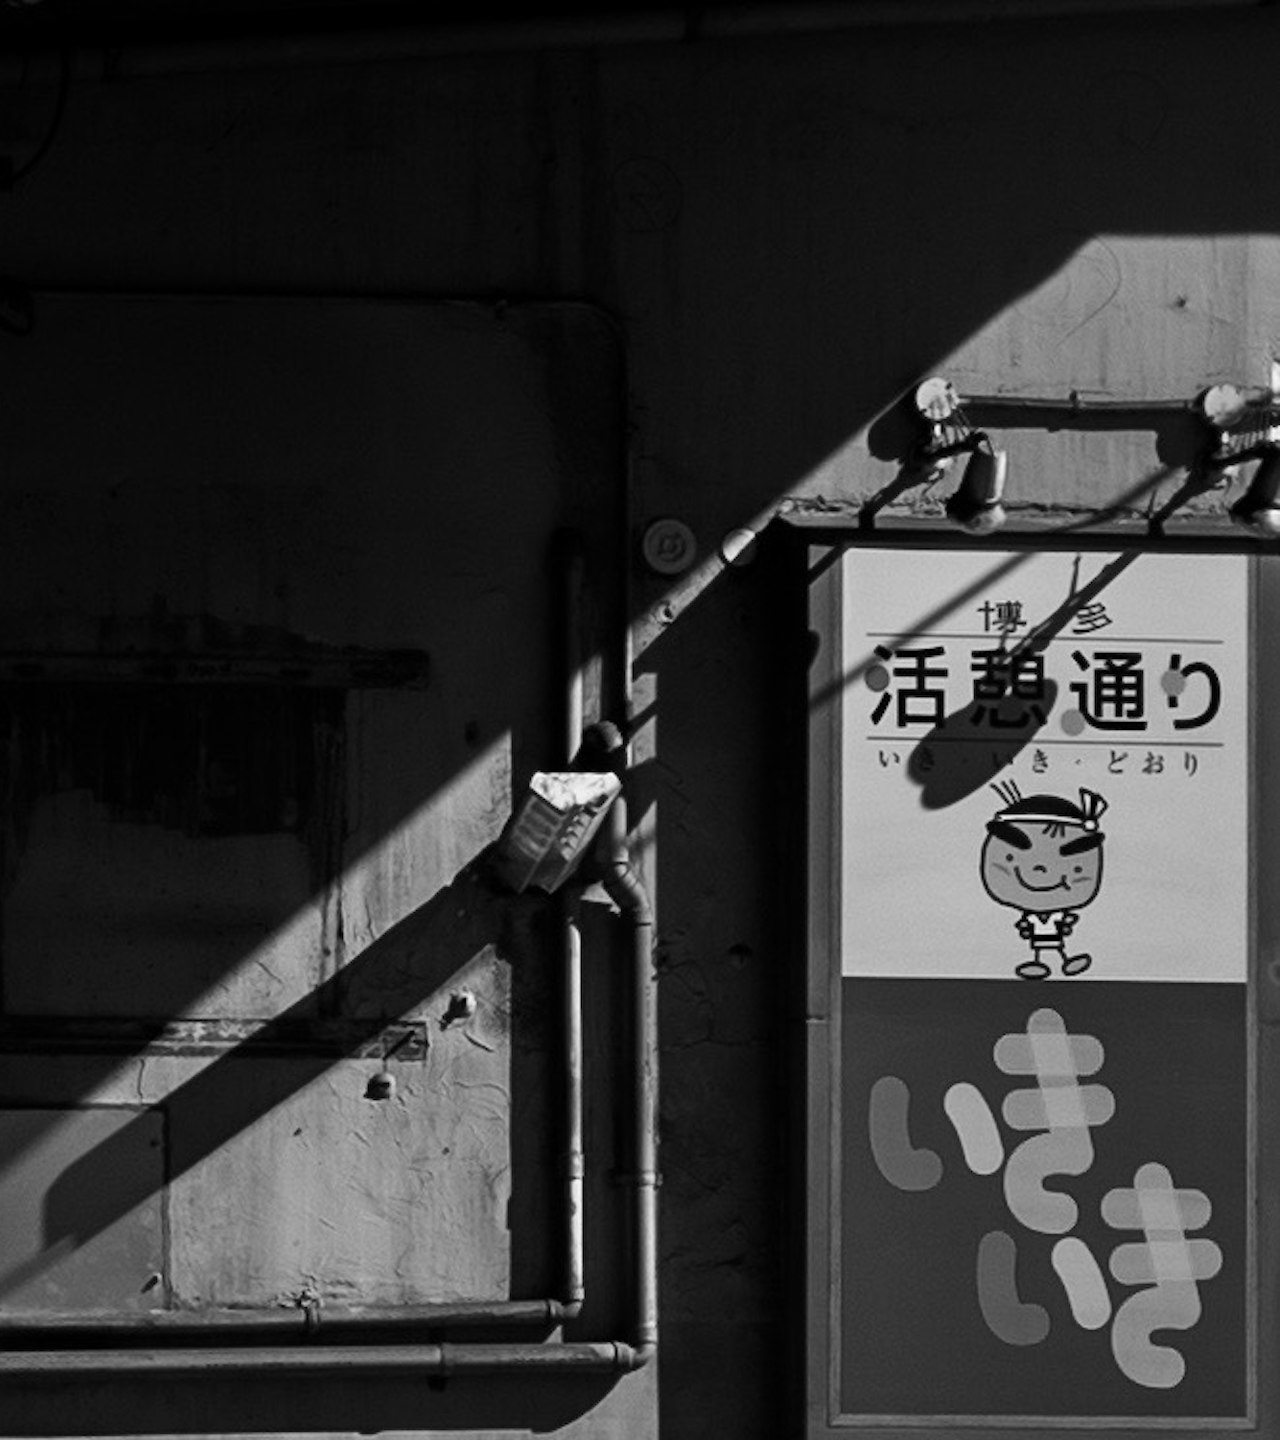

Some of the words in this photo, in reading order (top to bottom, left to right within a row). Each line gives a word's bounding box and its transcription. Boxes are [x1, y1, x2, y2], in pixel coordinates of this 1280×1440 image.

[978, 601, 1113, 635] 博多
[865, 645, 1221, 731] 活憩通り
